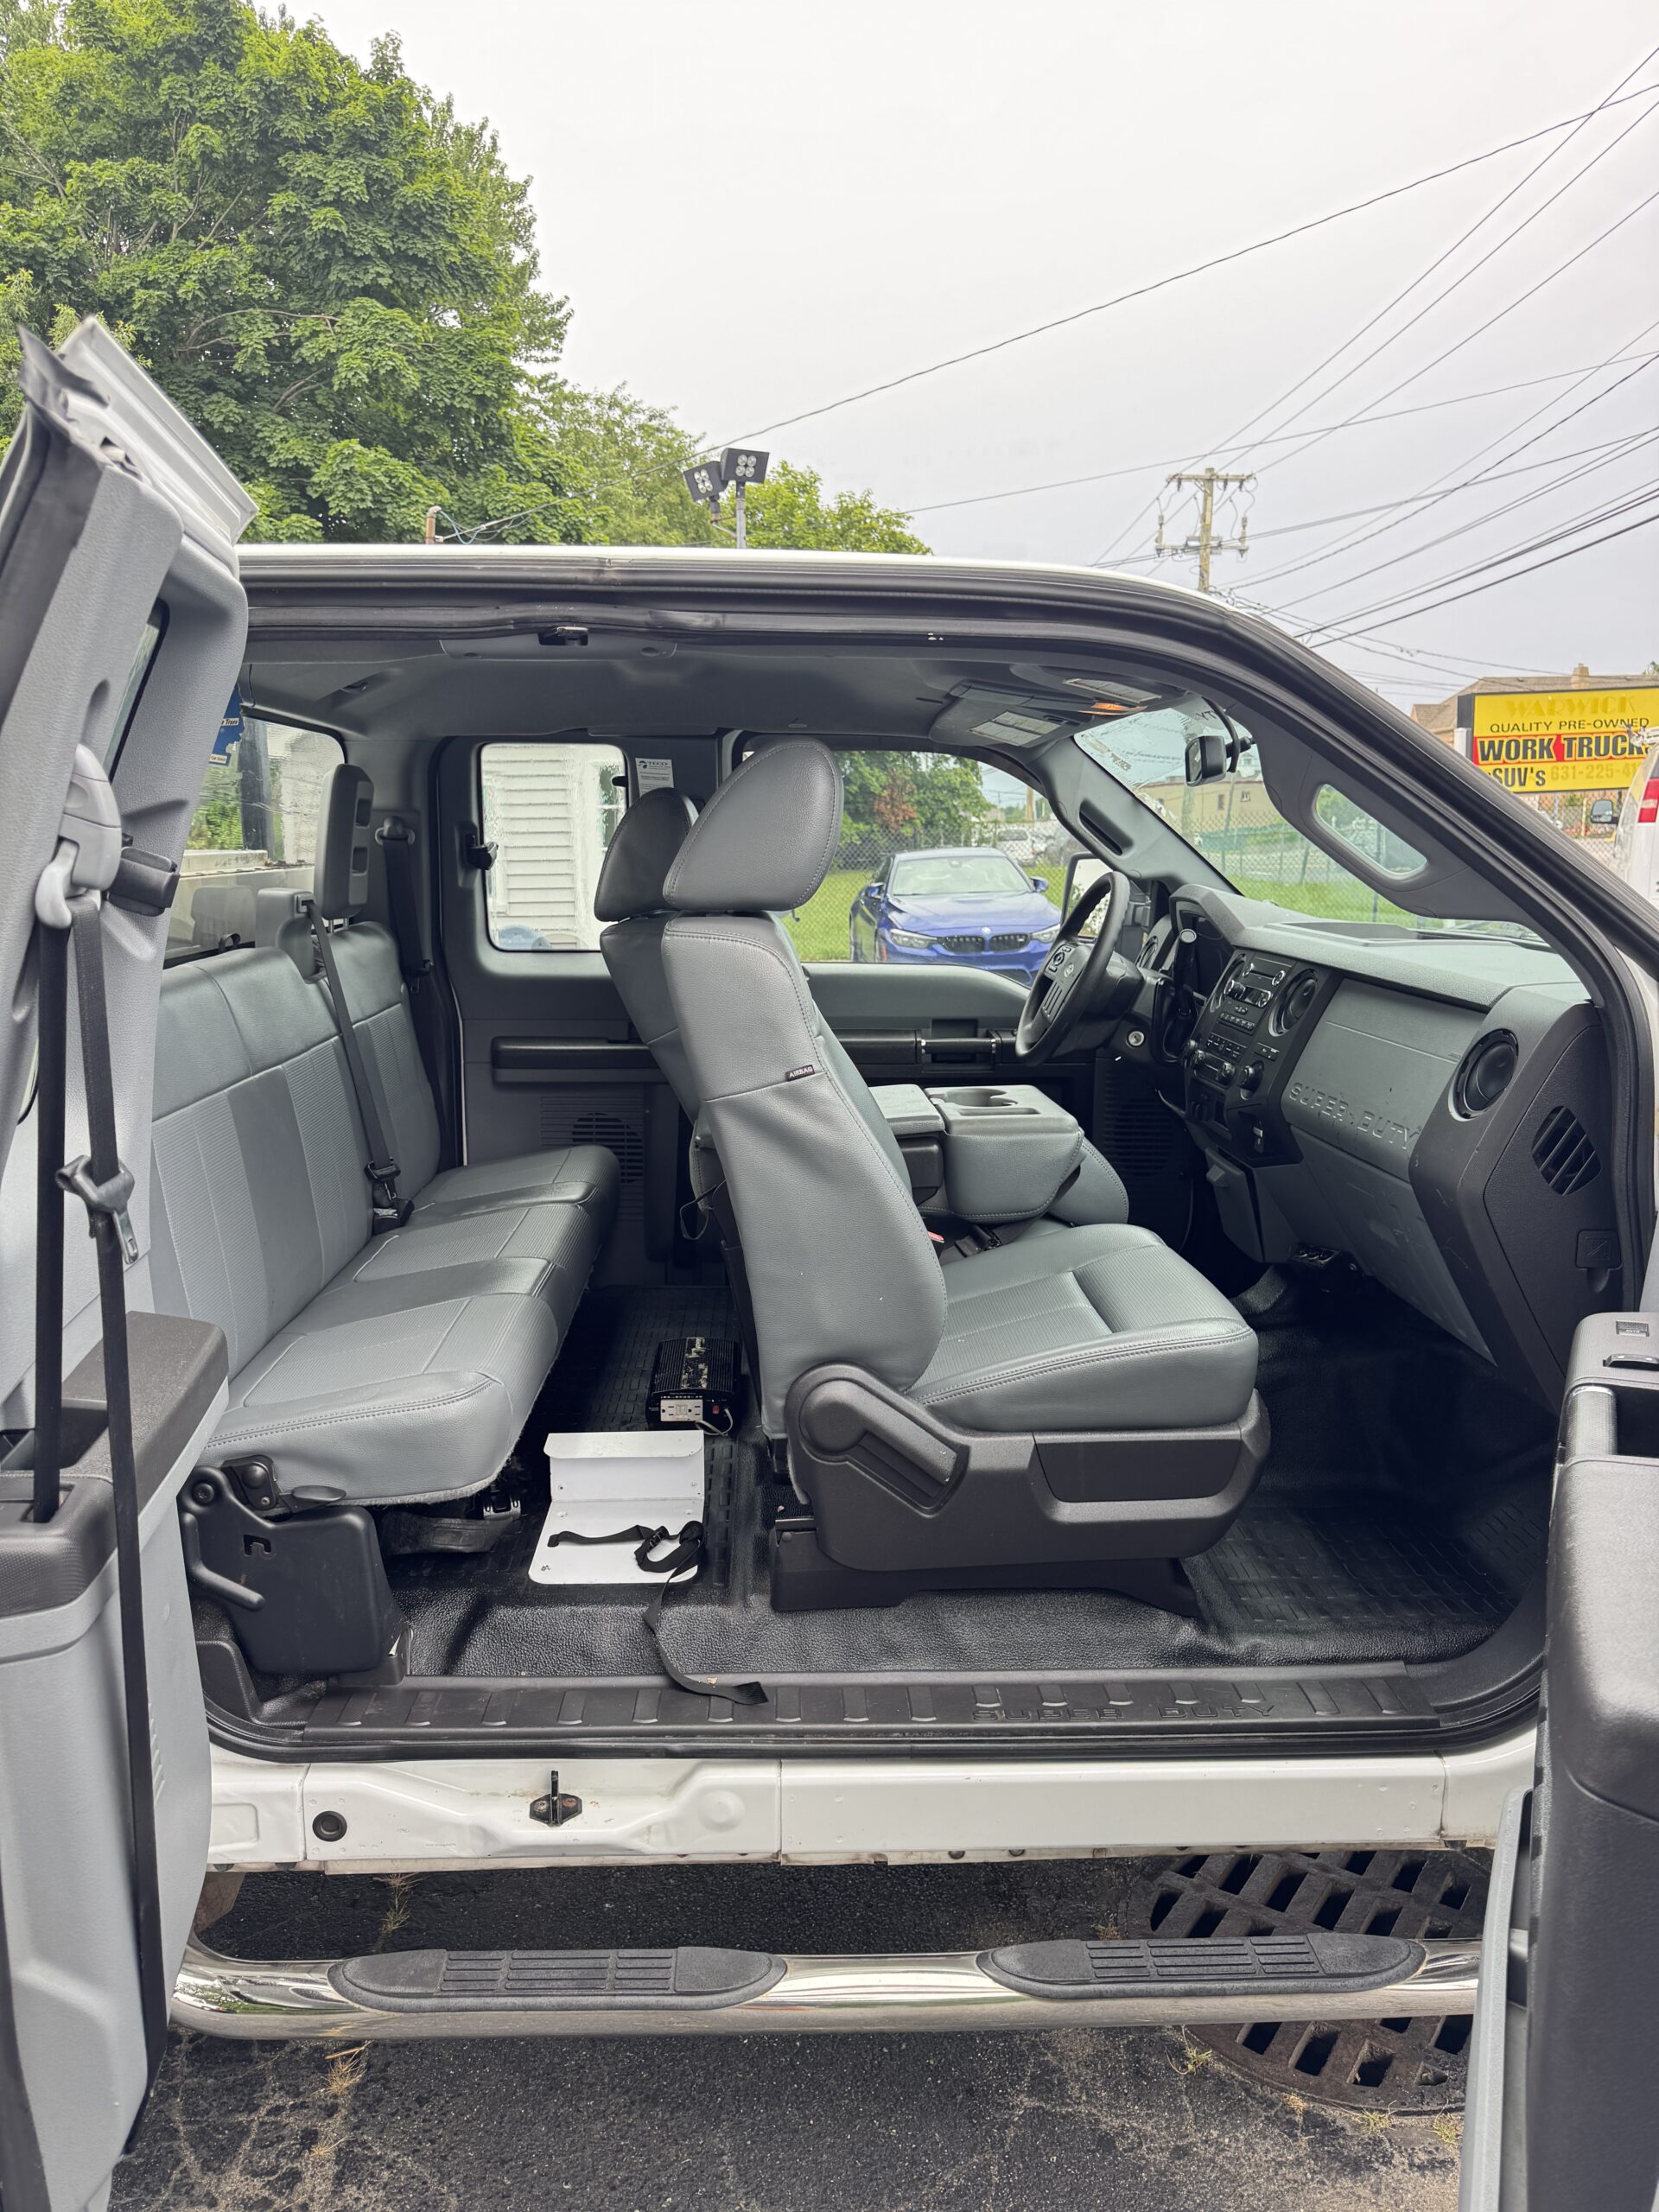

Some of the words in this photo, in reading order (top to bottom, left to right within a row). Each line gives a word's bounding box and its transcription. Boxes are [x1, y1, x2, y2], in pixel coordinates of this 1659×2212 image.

[1490, 721, 1554, 733] QUALITY
[1559, 717, 1649, 730] PRE-OWNED
[1478, 737, 1555, 762] WORK
[1563, 734, 1648, 759] TRUCK
[789, 1066, 813, 1078] AIRBAG
[1289, 1083, 1349, 1122] SUPER
[1357, 1110, 1419, 1149] DUTY
[972, 1708, 1124, 1721] SUPER
[1157, 1705, 1275, 1719] DUTY
